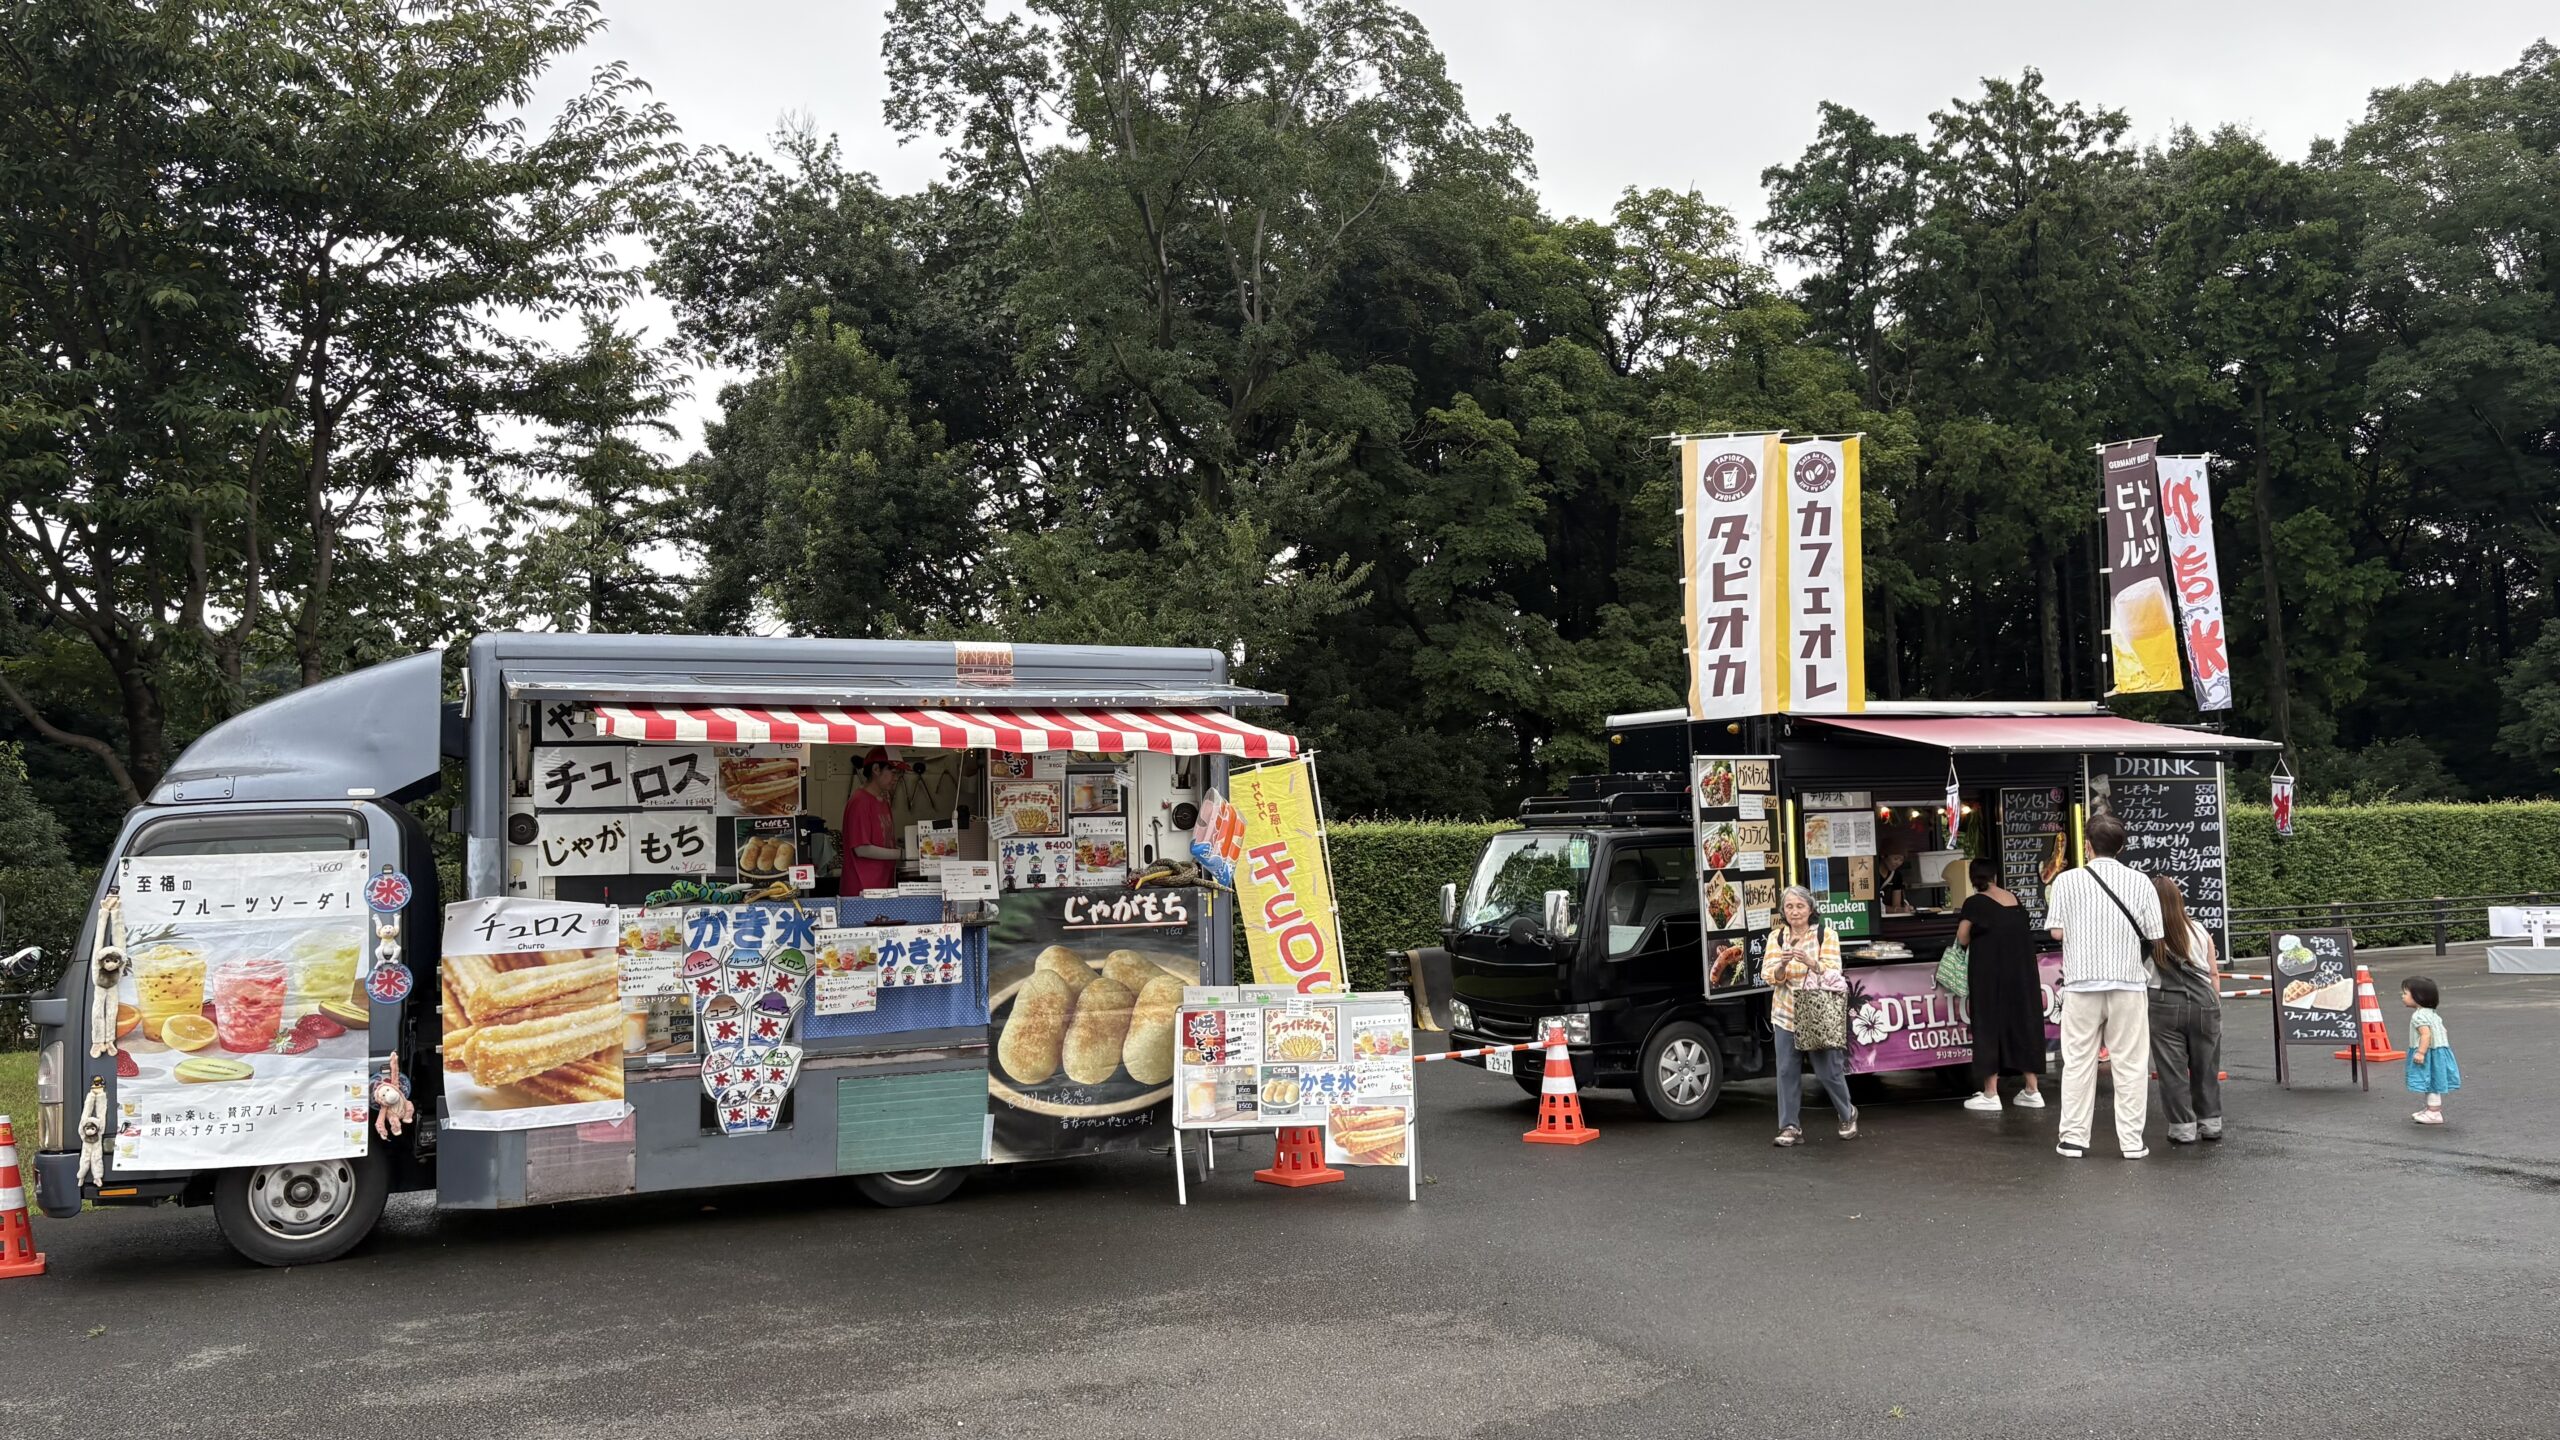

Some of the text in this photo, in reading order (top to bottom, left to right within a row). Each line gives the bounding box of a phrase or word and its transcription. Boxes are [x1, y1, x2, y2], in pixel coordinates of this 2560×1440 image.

[1715, 455, 1745, 465] TAPIOKA
[2108, 453, 2150, 470] GERMANY BEER
[2116, 484, 2143, 568] ビール
[2138, 480, 2160, 564] ドイツ
[1708, 513, 1751, 697] タピオカ
[1797, 500, 1837, 700] カフェオレ
[2115, 757, 2200, 776] DRINK
[545, 752, 711, 805] チュロス
[2195, 784, 2216, 794] 550
[1000, 791, 1055, 807] フライドポテト
[2195, 795, 2216, 805] 500
[2194, 806, 2216, 816] 550
[2201, 821, 2220, 832] 600
[542, 820, 705, 868] じゃがもち
[1002, 841, 1039, 857] かき氷
[1765, 854, 1780, 865] 950
[136, 875, 192, 894] 至福の
[375, 877, 404, 906] 氷
[2199, 877, 2222, 889] 550
[2197, 890, 2222, 901] 550
[1064, 893, 1188, 925] じゃがもち
[2199, 906, 2222, 916] 600
[473, 912, 588, 941] チュロス
[687, 905, 817, 950] かき氷
[1824, 917, 1855, 930] Draft
[517, 942, 545, 951] Churro
[878, 934, 962, 968] かき氷
[688, 958, 712, 971] いちご
[779, 956, 804, 970] メロン
[2320, 961, 2343, 972] 650
[376, 969, 405, 997] 氷
[695, 976, 717, 995] 氷
[736, 969, 757, 989] 氷
[773, 974, 796, 992] 氷
[710, 1006, 738, 1017] コーラ
[717, 1021, 738, 1039] 氷
[757, 1018, 779, 1037] 氷
[1272, 1019, 1330, 1035] フライドポテト
[1189, 1014, 1221, 1062] 焼そば
[1908, 1028, 1972, 1050] GLOBAL
[1300, 1071, 1357, 1092] かき氷
